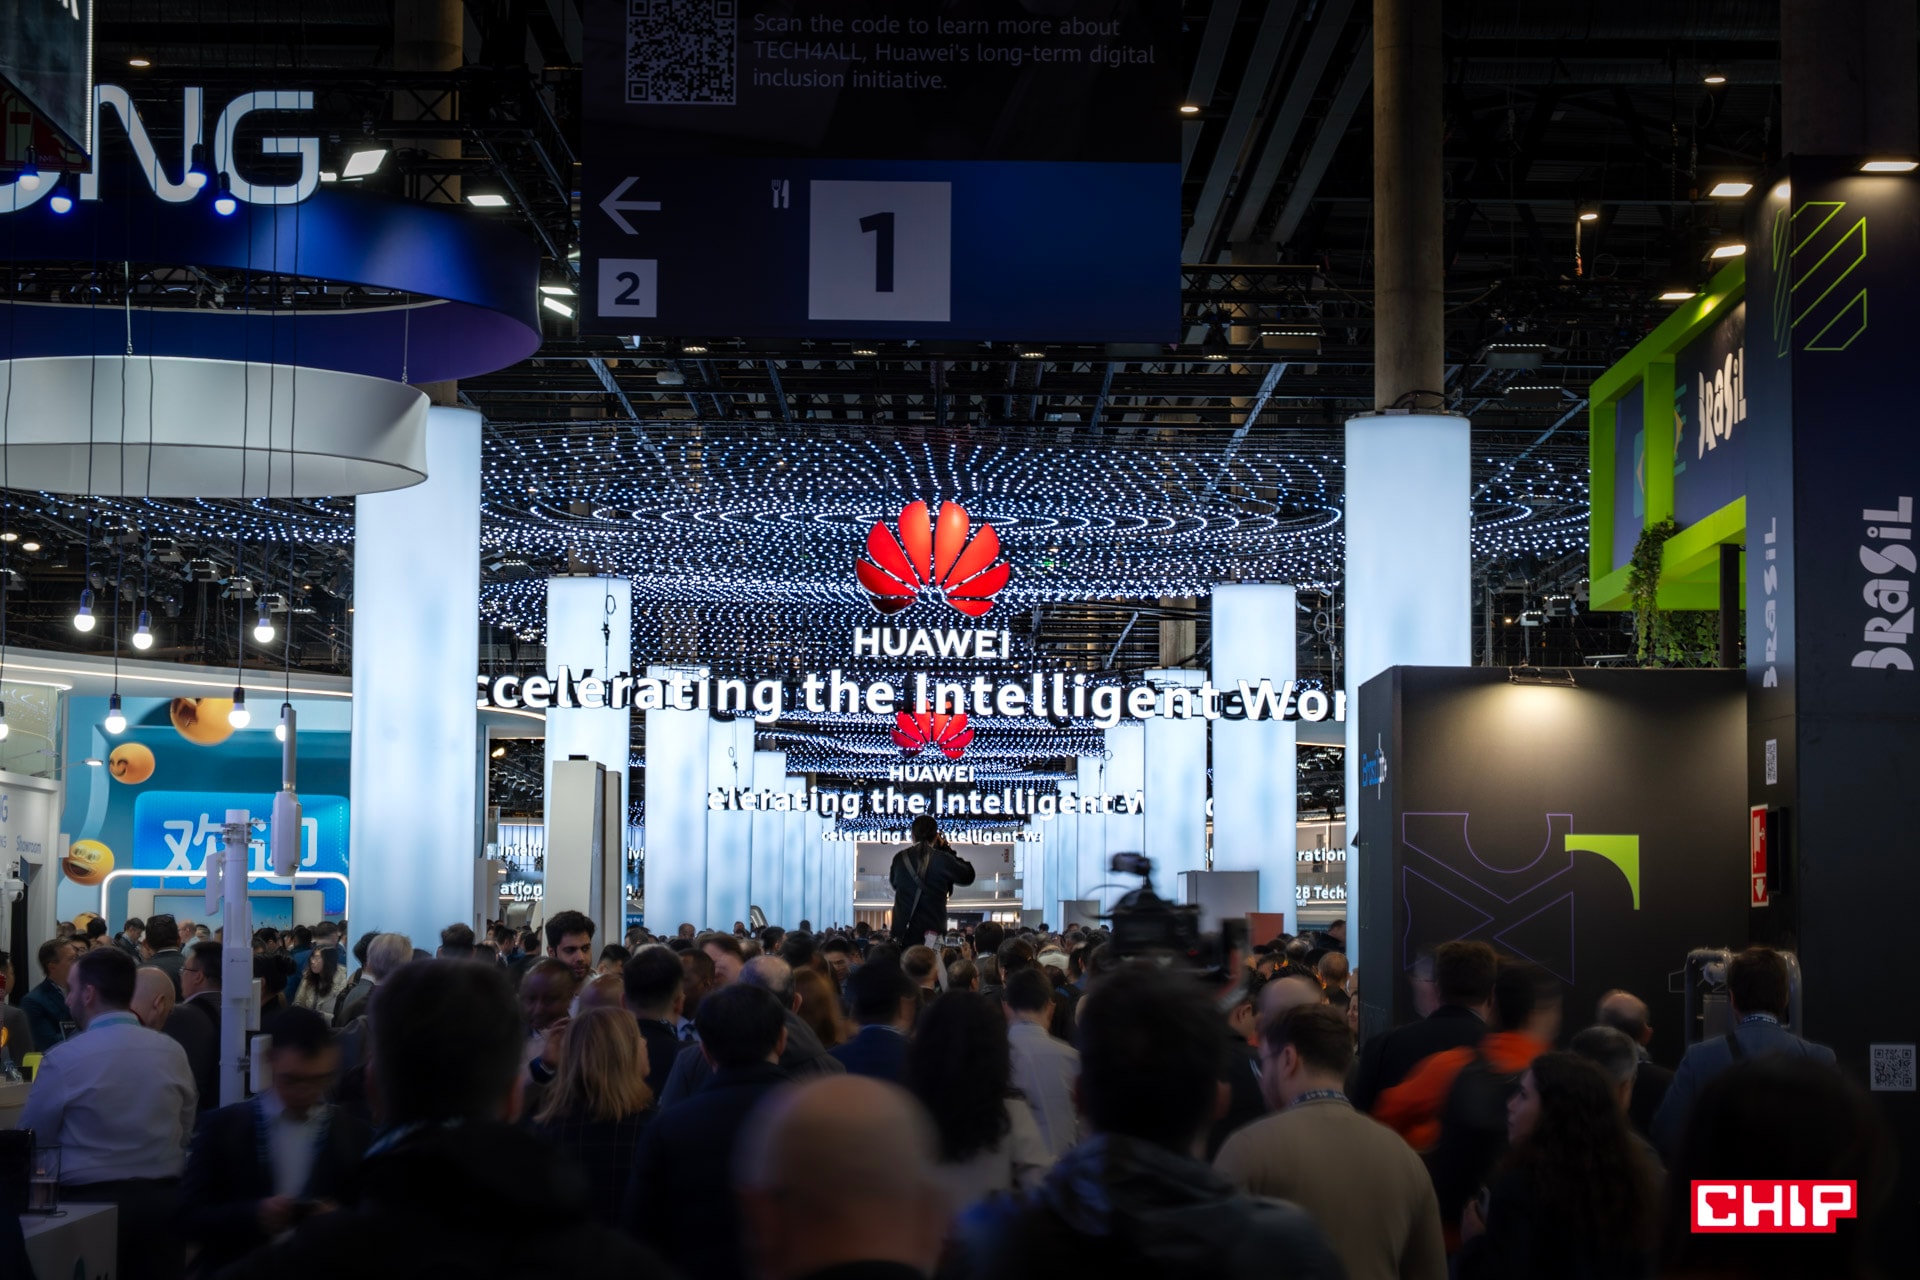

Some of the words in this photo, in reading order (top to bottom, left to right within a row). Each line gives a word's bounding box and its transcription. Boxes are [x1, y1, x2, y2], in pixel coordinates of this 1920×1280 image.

[753, 12, 802, 32] Scan
[810, 14, 844, 33] the
[851, 15, 900, 34] code
[908, 17, 929, 34] to
[937, 16, 989, 34] learn
[999, 19, 1051, 35] more
[1059, 16, 1120, 36] about
[753, 41, 867, 63] TECH4ALL,
[876, 42, 970, 62] Huawei's
[977, 43, 1082, 67] long-term
[1089, 45, 1155, 68] digital
[753, 68, 845, 87] inclusion
[852, 70, 948, 89] initiative.
[0, 84, 321, 214] NG
[859, 212, 894, 292] 1
[614, 272, 640, 305] 2
[853, 627, 1009, 659] HUAWEI
[803, 669, 894, 714] the
[916, 672, 1220, 728] Intelligent
[889, 765, 975, 783] HUAWEI
[708, 786, 862, 819] elerating
[871, 787, 925, 814] the
[936, 788, 1118, 822] Intelligent
[1314, 885, 1347, 900] Tech
